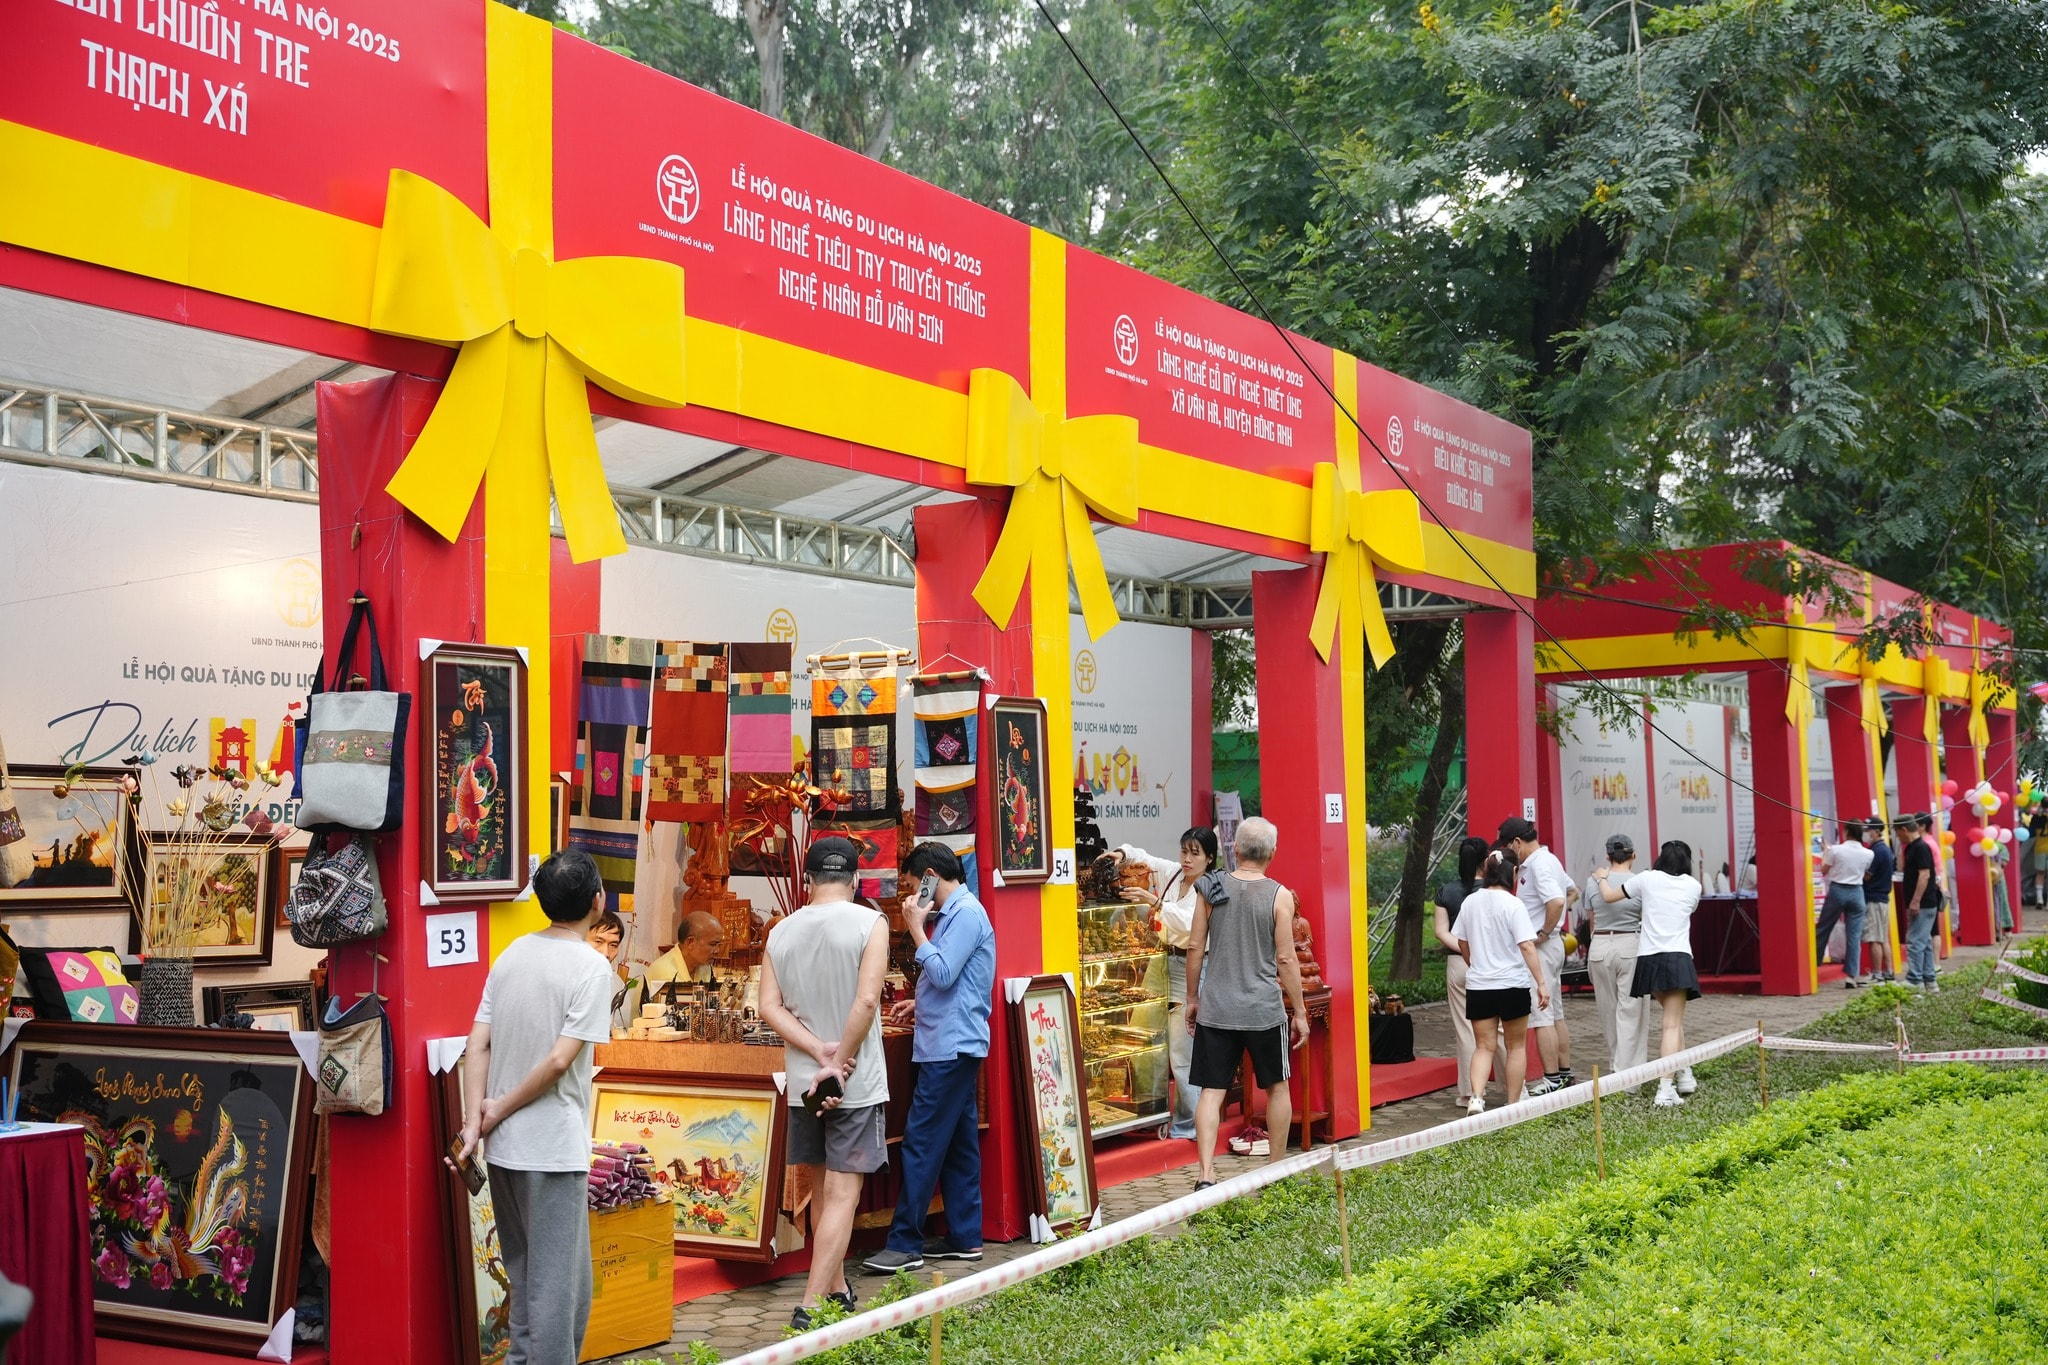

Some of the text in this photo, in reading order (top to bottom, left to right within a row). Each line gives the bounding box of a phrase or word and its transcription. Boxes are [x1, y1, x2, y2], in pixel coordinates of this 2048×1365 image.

[136, 0, 310, 88] CHUỒN TRE
[296, 7, 339, 40] NỘI
[346, 23, 401, 63] 2025
[80, 38, 248, 135] THẠCH XÁ
[638, 222, 656, 235] UBND
[657, 227, 678, 242] THÀNH
[679, 235, 692, 246] PHỐ
[693, 239, 702, 249] HÀ
[731, 163, 982, 276] LỄ HỘI QUÀ TẶNG DU LỊCH HÀ NỘI 2025
[723, 200, 986, 318] LÀNG NGHỀ THÊU TAY TRUYỀN THỐNG
[779, 267, 943, 344] NGHỆ NHÂN ĐỖ VĂN SƠN
[1155, 316, 1304, 388] LỄ HỘI QUÀ TẶNG DU LỊCH HÀ NỘI 2025
[1157, 347, 1181, 378] LÀNG
[1184, 359, 1207, 387] NGHỀ
[1209, 362, 1220, 391] GỖ
[1223, 371, 1236, 396] MỸ
[1239, 379, 1260, 408] NGHỆ
[1262, 387, 1285, 413] THIẾT
[1172, 388, 1184, 414] XÃ
[1187, 393, 1205, 420] VÂN
[1224, 406, 1251, 437] HUYỆN
[1254, 414, 1275, 442] ĐÔNG
[1277, 423, 1293, 447] ANH
[251, 637, 273, 646] UBND
[274, 637, 300, 648] THÀNH
[302, 639, 318, 649] PHỐ
[122, 656, 139, 679] LỄ
[145, 661, 175, 685] HỘI
[180, 662, 217, 684] QUÀ
[222, 666, 265, 687] TẶNG
[270, 671, 291, 687] DU
[48, 699, 147, 767] Du
[152, 717, 199, 757] lịch
[1074, 722, 1082, 731] DU
[1085, 722, 1097, 733] LỊCH
[1099, 721, 1108, 733] HÀ
[1123, 724, 1137, 734] 2025
[1105, 801, 1124, 818] SẢN
[1126, 801, 1140, 818] THẾ
[1142, 801, 1160, 818] GIỚI
[1330, 802, 1339, 817] 55
[1526, 805, 1533, 818] 56
[1056, 860, 1070, 877] 54
[441, 928, 466, 955] 53
